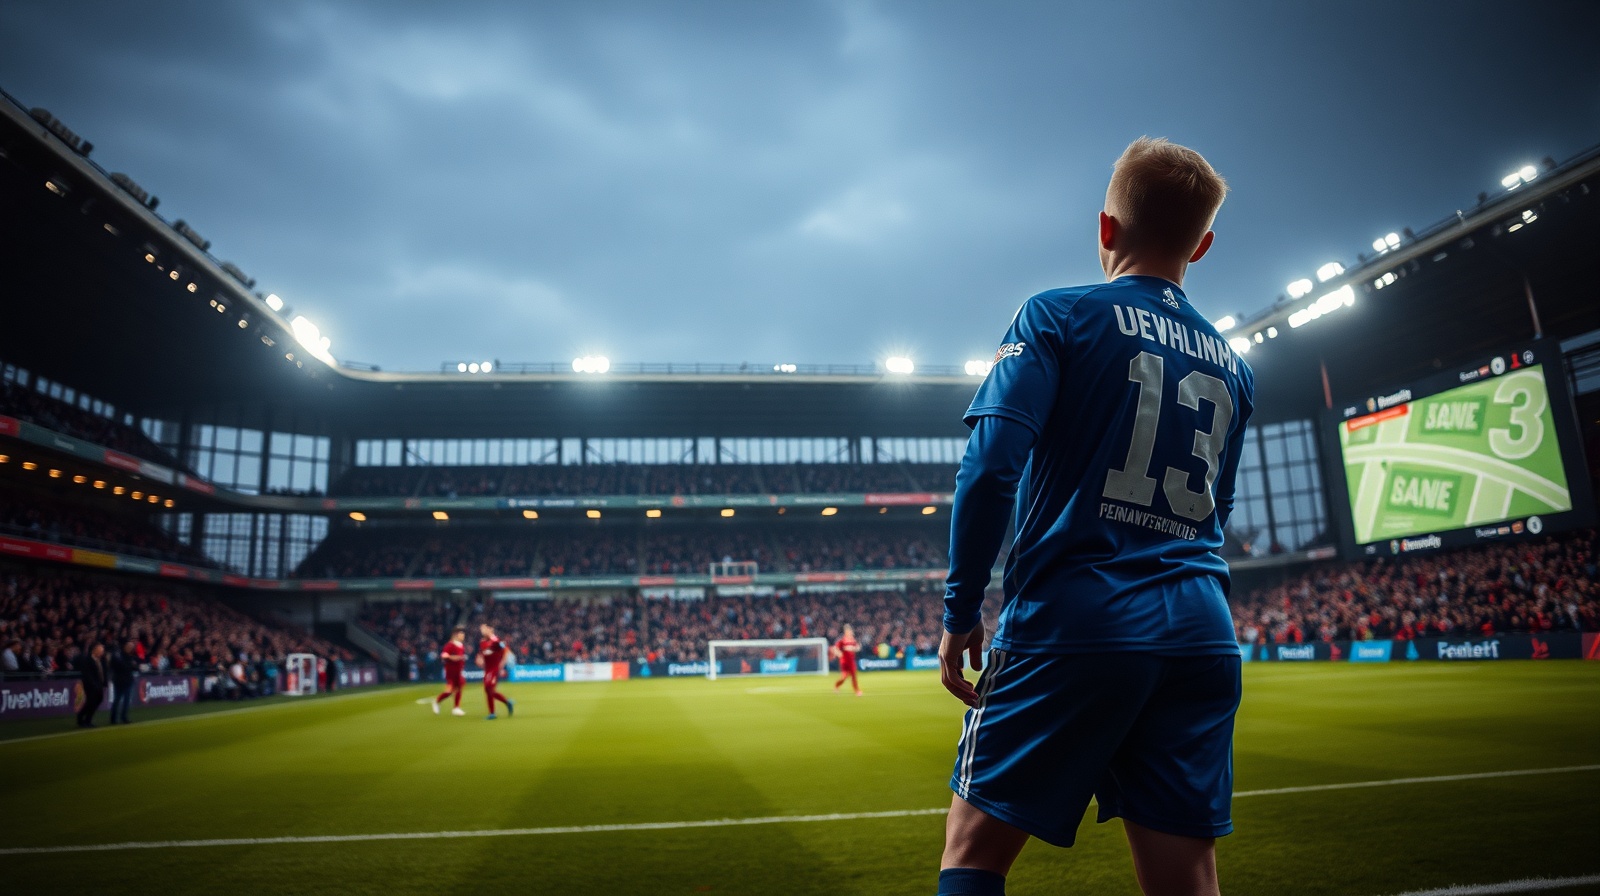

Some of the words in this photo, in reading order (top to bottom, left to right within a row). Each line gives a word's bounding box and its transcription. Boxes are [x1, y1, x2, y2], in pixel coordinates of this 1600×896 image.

[1102, 351, 1233, 522] 13
[1488, 370, 1546, 459] 3
[1391, 475, 1454, 511] SANE
